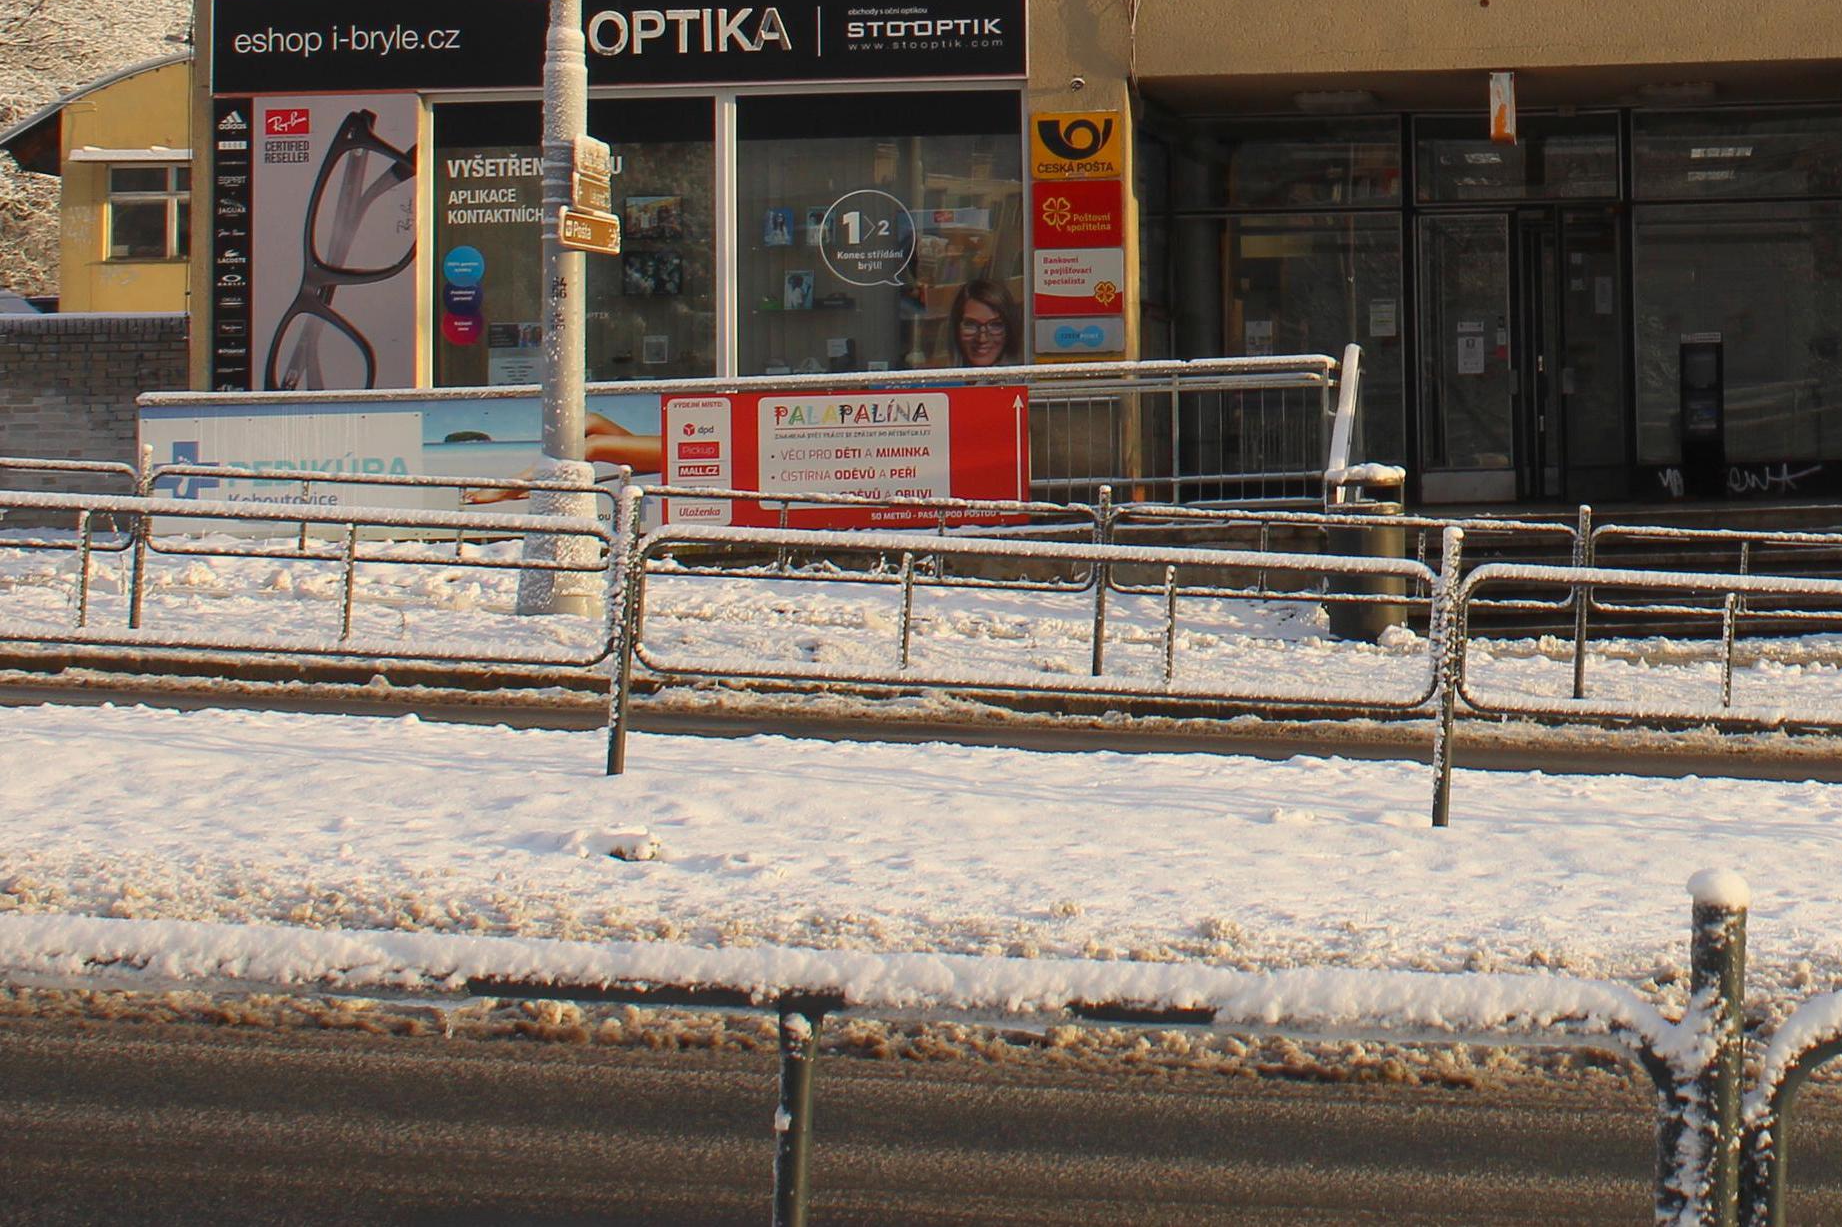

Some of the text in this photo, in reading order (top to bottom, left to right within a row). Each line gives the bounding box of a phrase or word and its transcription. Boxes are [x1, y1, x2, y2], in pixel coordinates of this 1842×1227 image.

[848, 7, 878, 16] obchody
[901, 7, 928, 16] optikou
[588, 7, 792, 56] OPTIKA
[847, 18, 1002, 38] STOOPTIK
[235, 24, 461, 57] eshop i-bryle.cz
[848, 39, 1003, 51] www.stooptik.com
[218, 122, 247, 130] adidas
[265, 141, 309, 152] CERTIFIED
[265, 152, 309, 163] RESELLER
[447, 154, 544, 178] VYŠETŘEN
[1037, 160, 1113, 173] ČESKÁ POŠTA
[448, 188, 516, 204] APLIKACE
[448, 205, 544, 224] KONTAKTNÍCH
[1073, 213, 1111, 221] Poštovní
[877, 220, 890, 236] 2
[1067, 223, 1111, 233] spořitelna
[837, 249, 904, 260] Konec střídání
[1043, 256, 1079, 264] Bankovní
[1044, 278, 1086, 287] specialista
[774, 399, 929, 425] PALAPALÍNA
[698, 426, 714, 434] dpd
[781, 446, 930, 461] VĚCI PRO DĚTI A MIMINKA
[781, 465, 916, 481] ČISTÍRNA ODĚVŮ A PEŘÍ
[679, 506, 721, 518] Uloženka
